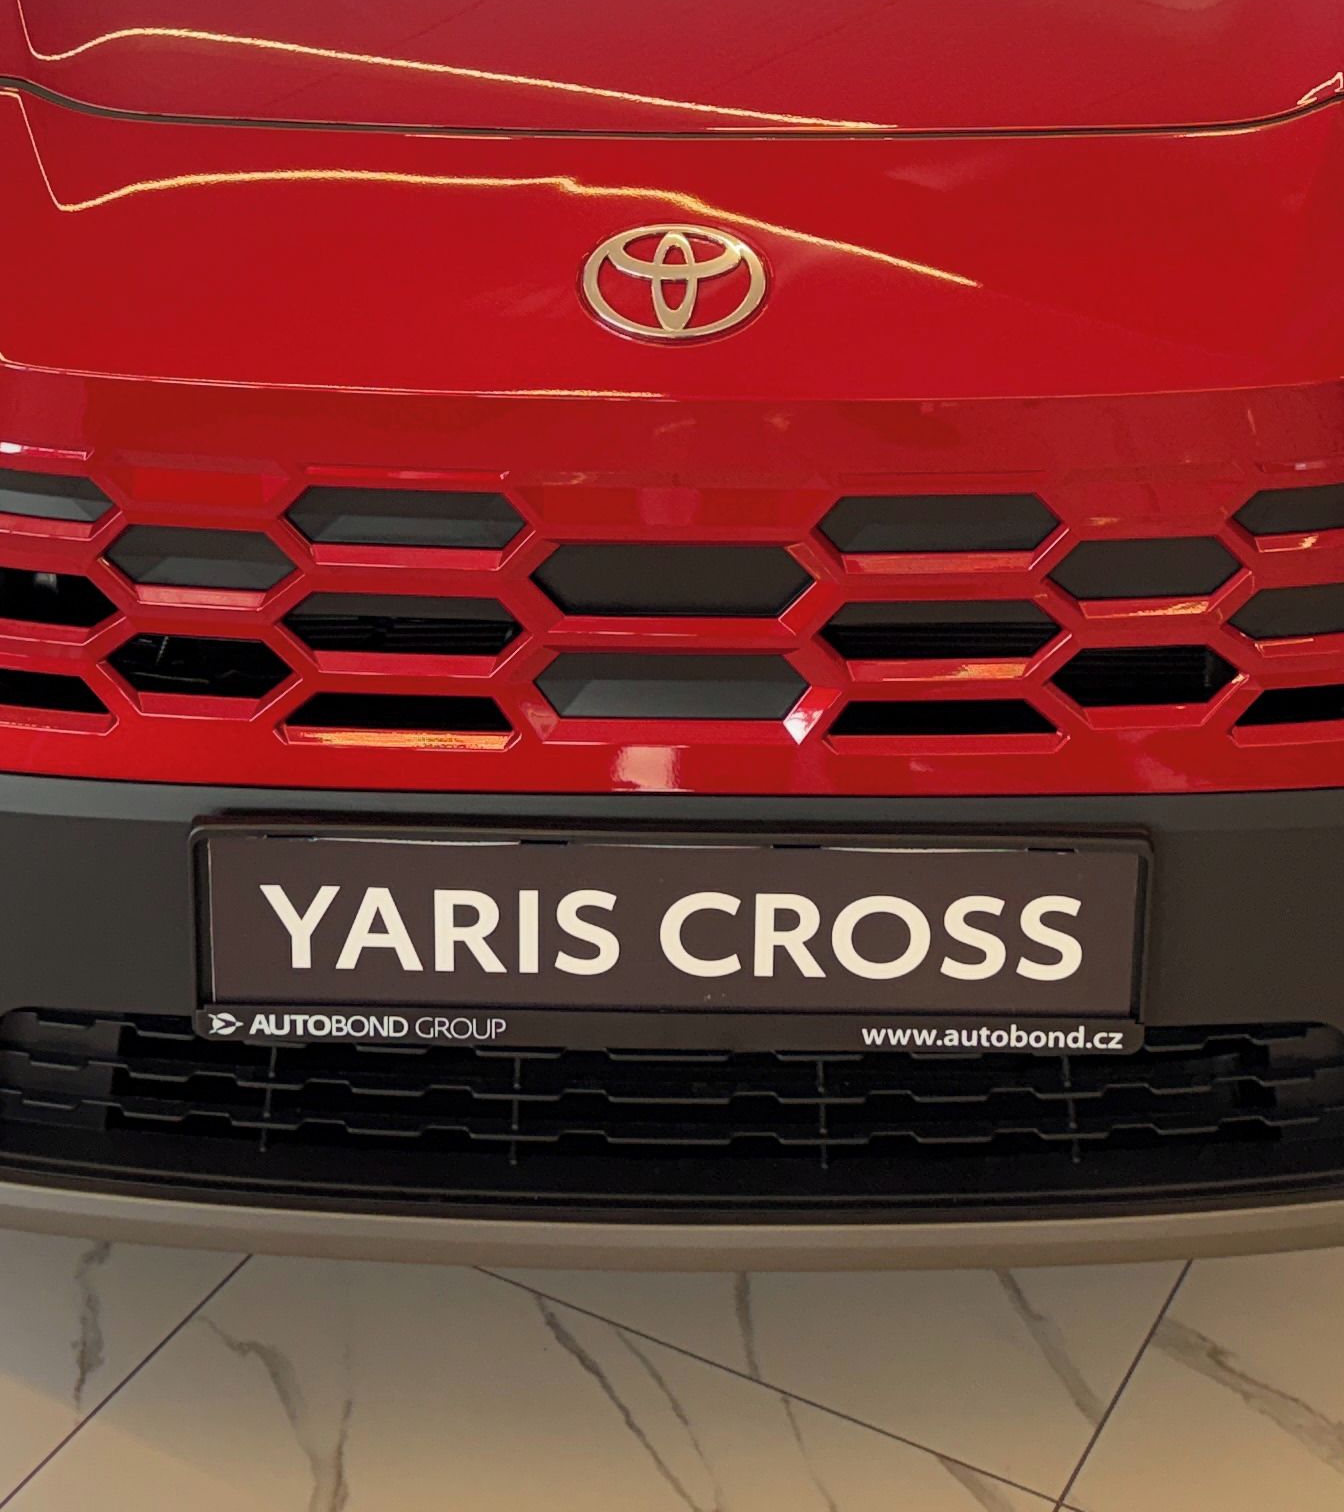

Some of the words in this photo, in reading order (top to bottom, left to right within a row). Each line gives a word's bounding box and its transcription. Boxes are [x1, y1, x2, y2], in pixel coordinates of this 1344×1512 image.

[259, 884, 621, 978] YARIS
[659, 891, 1083, 981] CROSS
[249, 1014, 408, 1038] AUTOBOND
[415, 1017, 507, 1039] GROUP
[861, 1024, 1124, 1050] www.autobond.cz
